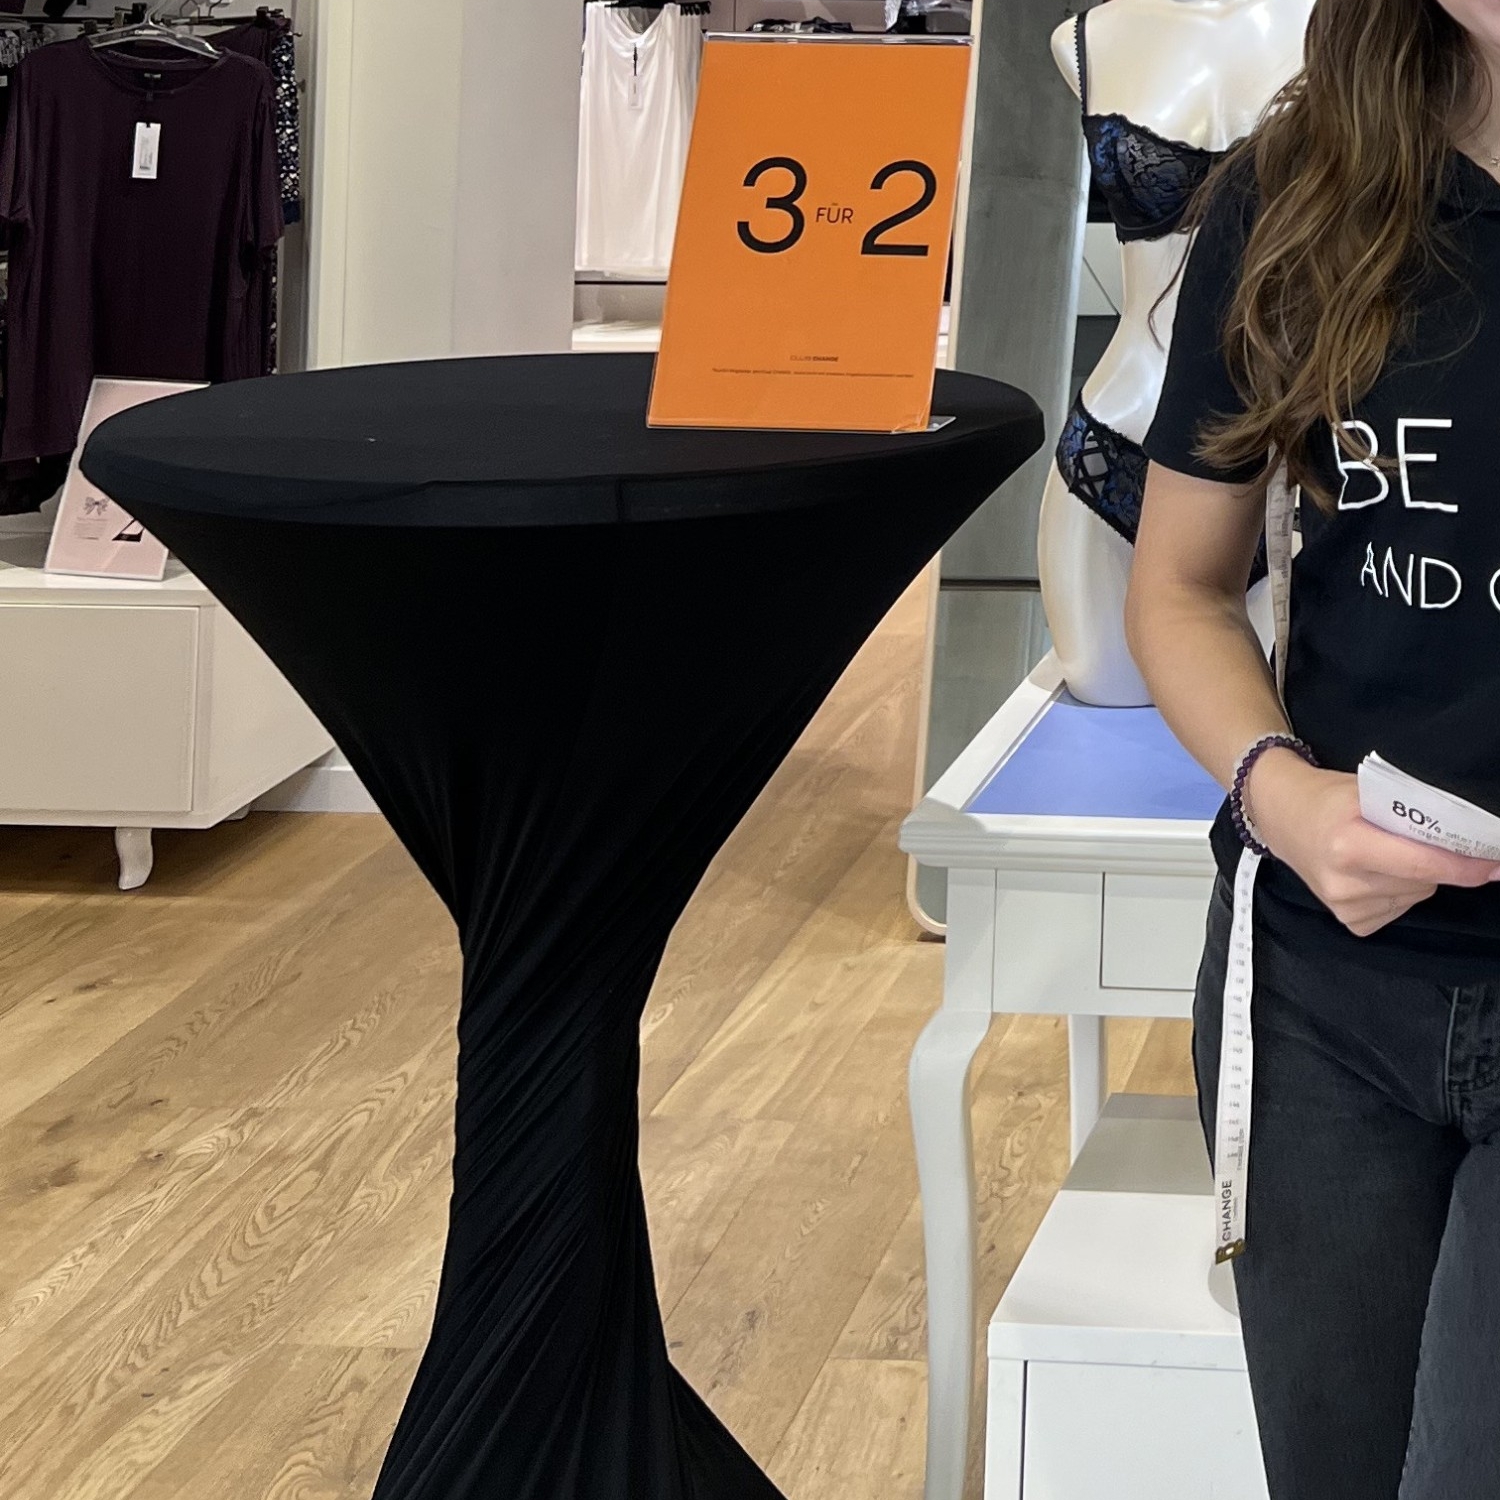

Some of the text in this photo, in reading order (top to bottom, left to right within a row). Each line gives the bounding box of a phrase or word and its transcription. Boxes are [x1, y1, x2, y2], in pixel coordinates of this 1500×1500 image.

[736, 156, 937, 256] 3 FÜR 2
[1332, 418, 1458, 513] BE
[1361, 541, 1463, 609] AND
[1392, 800, 1441, 834] 80%
[1221, 1179, 1232, 1242] CHANGE
